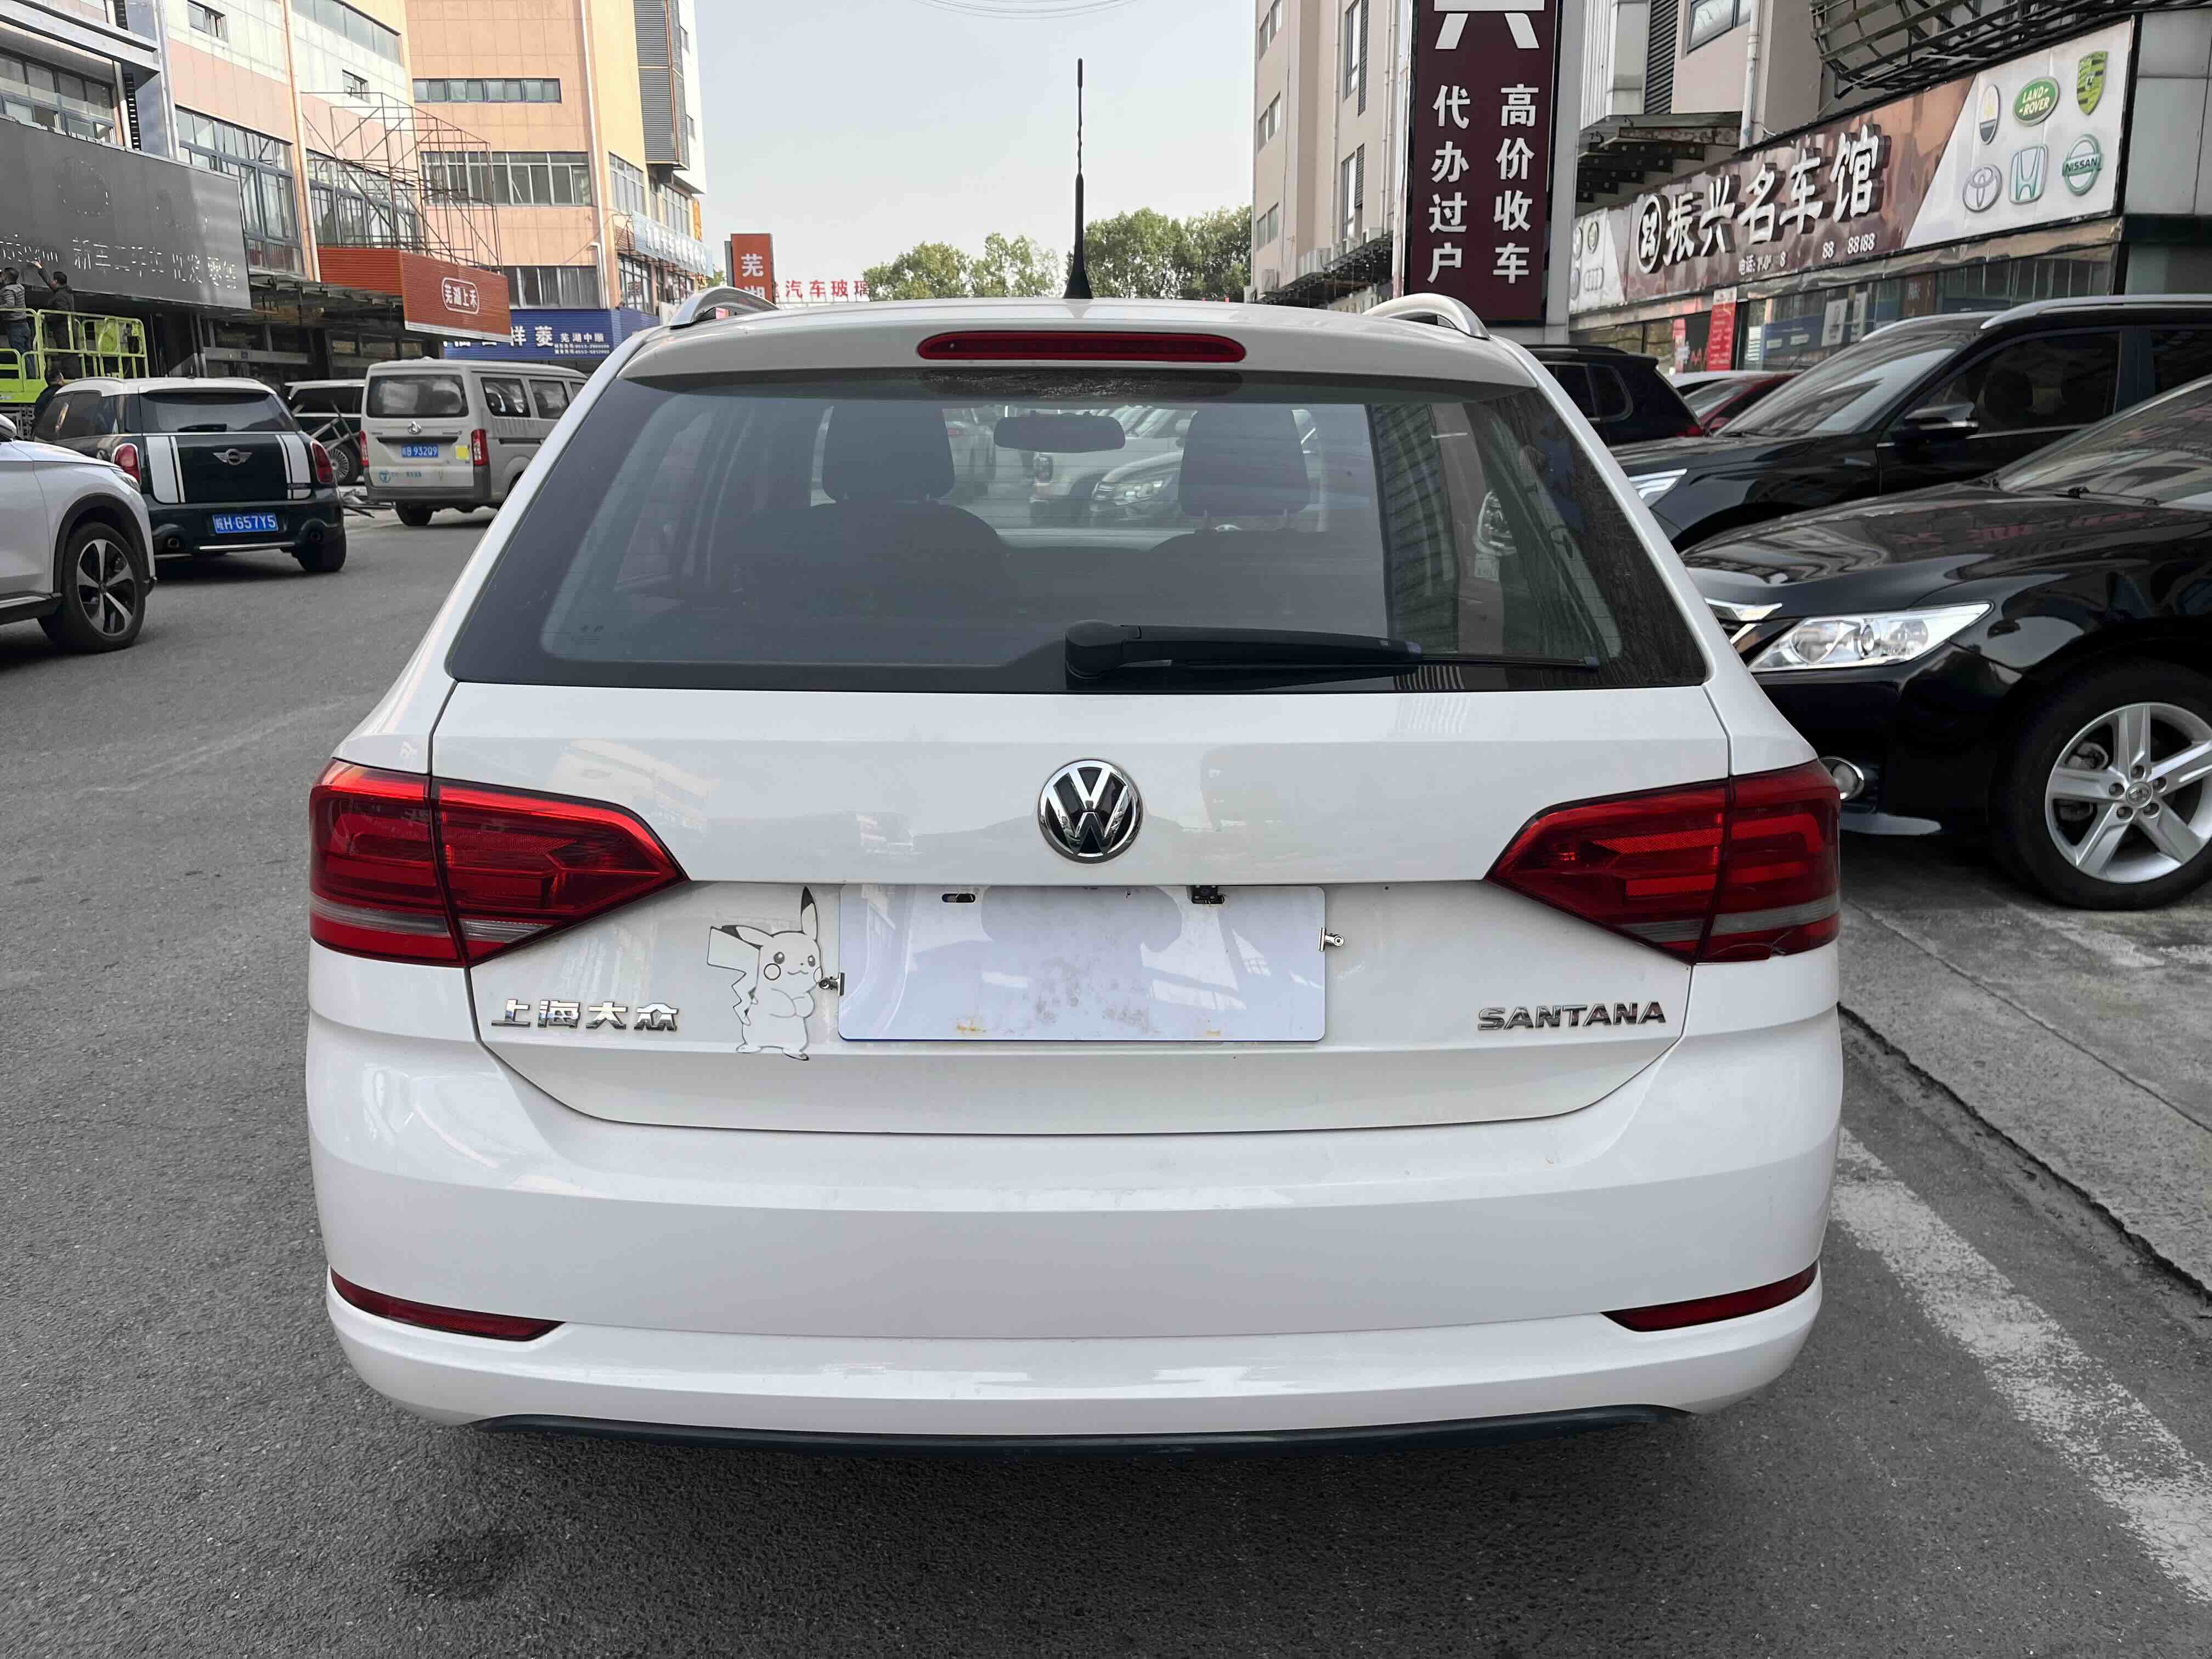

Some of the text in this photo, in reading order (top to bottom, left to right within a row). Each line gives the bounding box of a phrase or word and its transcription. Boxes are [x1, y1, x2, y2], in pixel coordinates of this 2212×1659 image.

[1426, 84, 1471, 284] 代办过户
[1492, 83, 1539, 284] 高价收车
[1662, 124, 1884, 267] 振兴名车馆
[2066, 157, 2097, 172] NISSAN
[491, 998, 680, 1031] 上海大众
[1477, 1001, 1667, 1031] SANTANA
